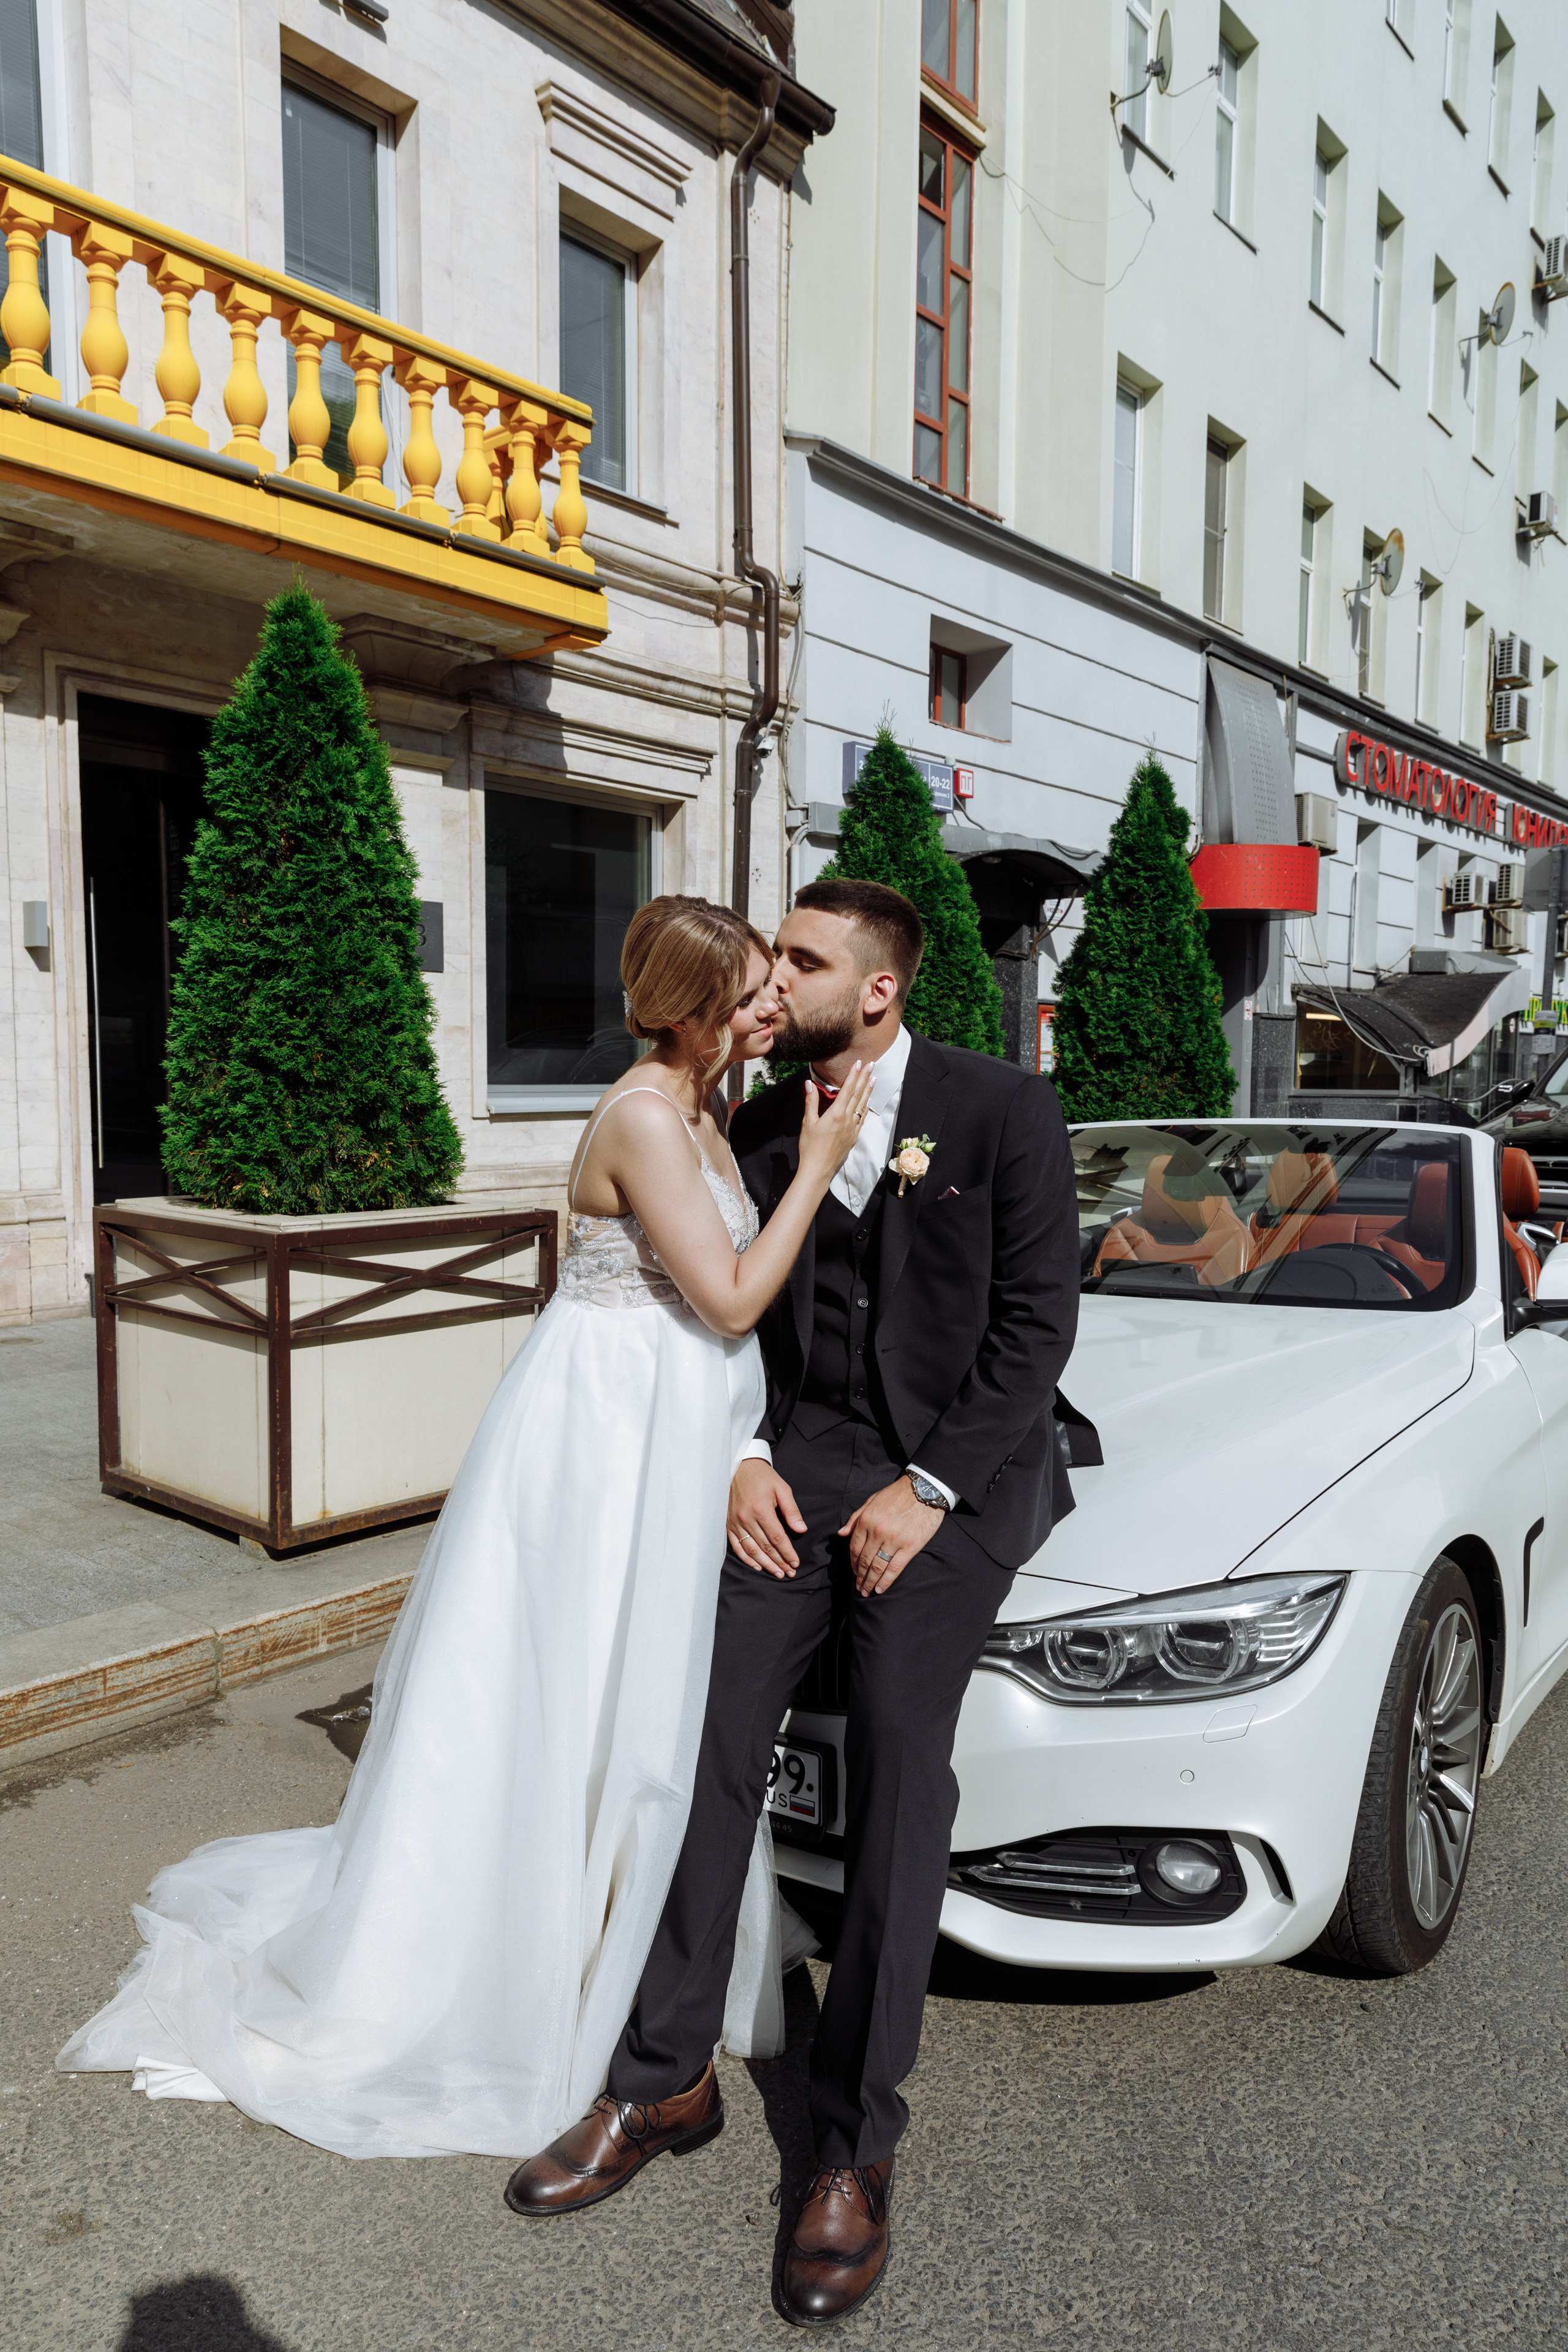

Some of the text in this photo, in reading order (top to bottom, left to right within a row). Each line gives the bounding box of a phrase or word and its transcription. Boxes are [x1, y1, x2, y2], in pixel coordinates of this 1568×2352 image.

[931, 775, 950, 790] 20-22
[960, 775, 971, 790] ПГ
[1347, 730, 1498, 834] СТОМАТОЛОГИЯ
[767, 1789, 788, 1808] US
